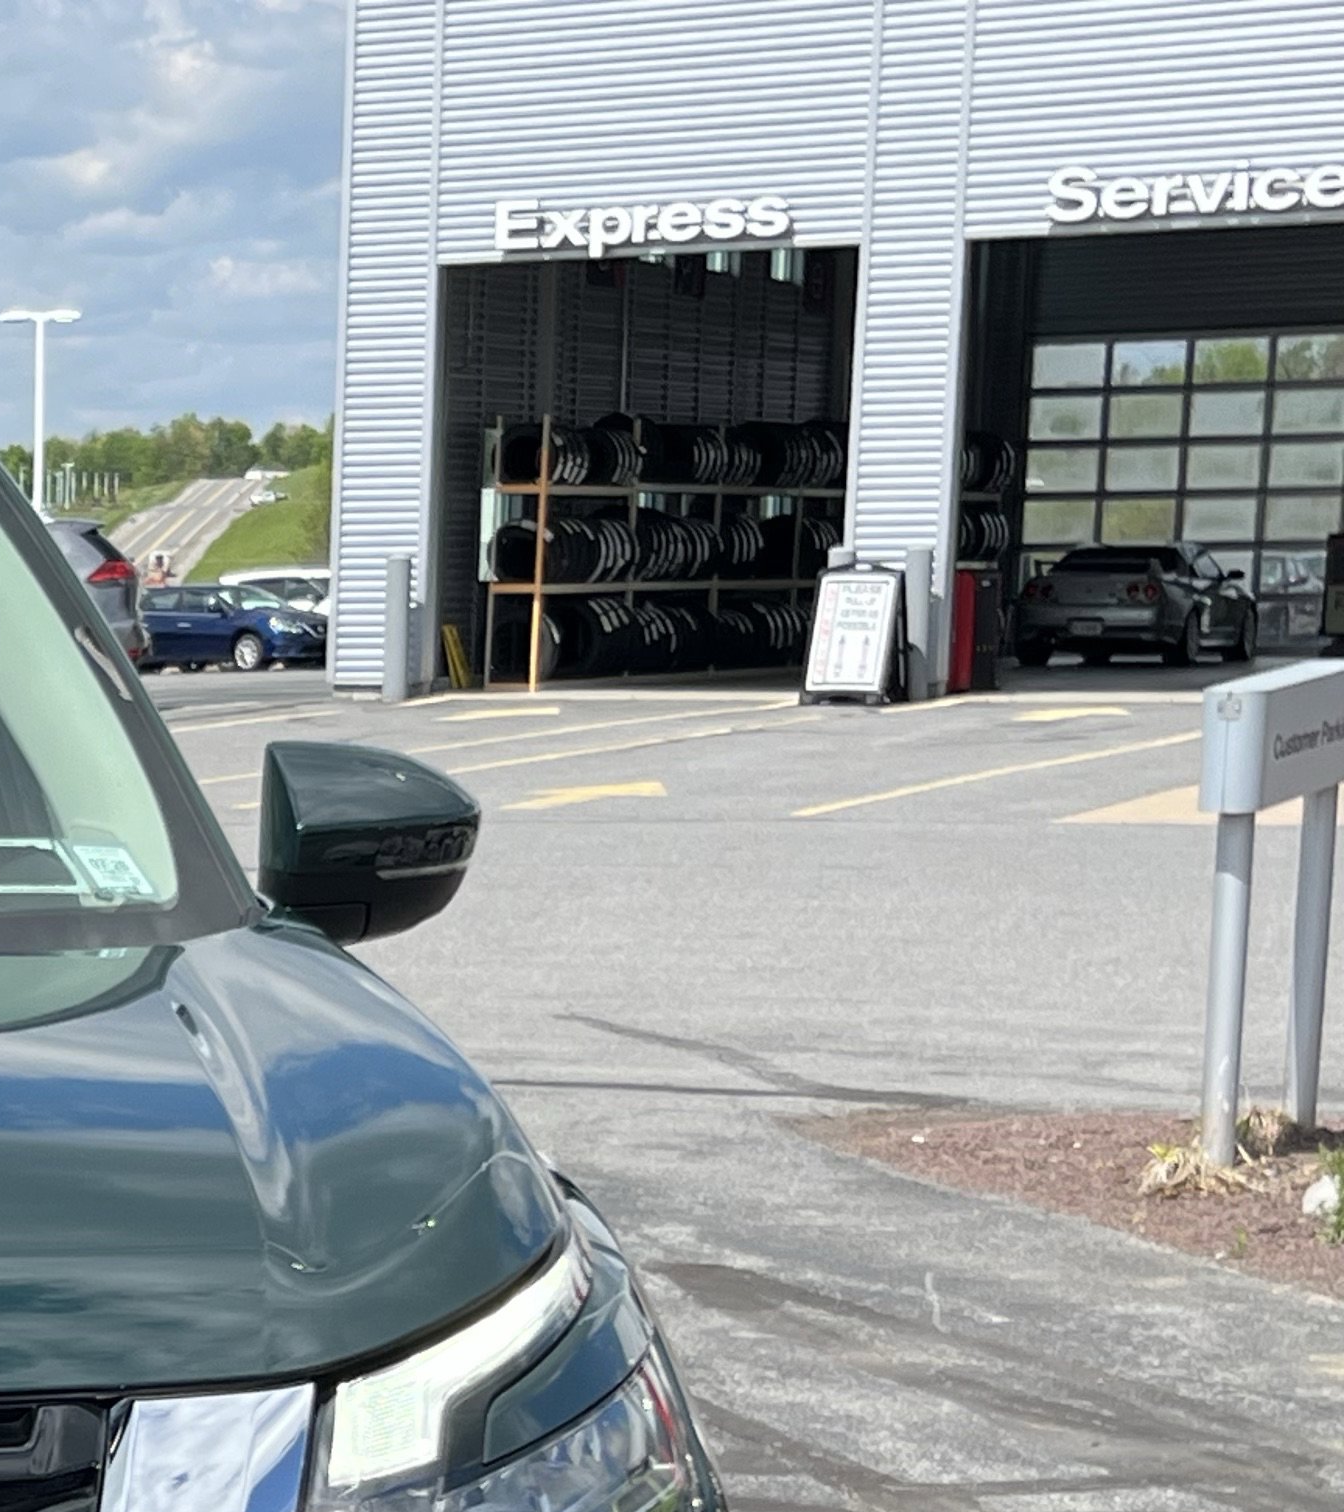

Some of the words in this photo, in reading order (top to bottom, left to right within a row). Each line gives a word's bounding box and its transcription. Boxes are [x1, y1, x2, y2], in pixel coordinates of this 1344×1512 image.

[1046, 159, 1344, 222] Service
[495, 195, 791, 258] Express
[1273, 730, 1320, 760] Customer
